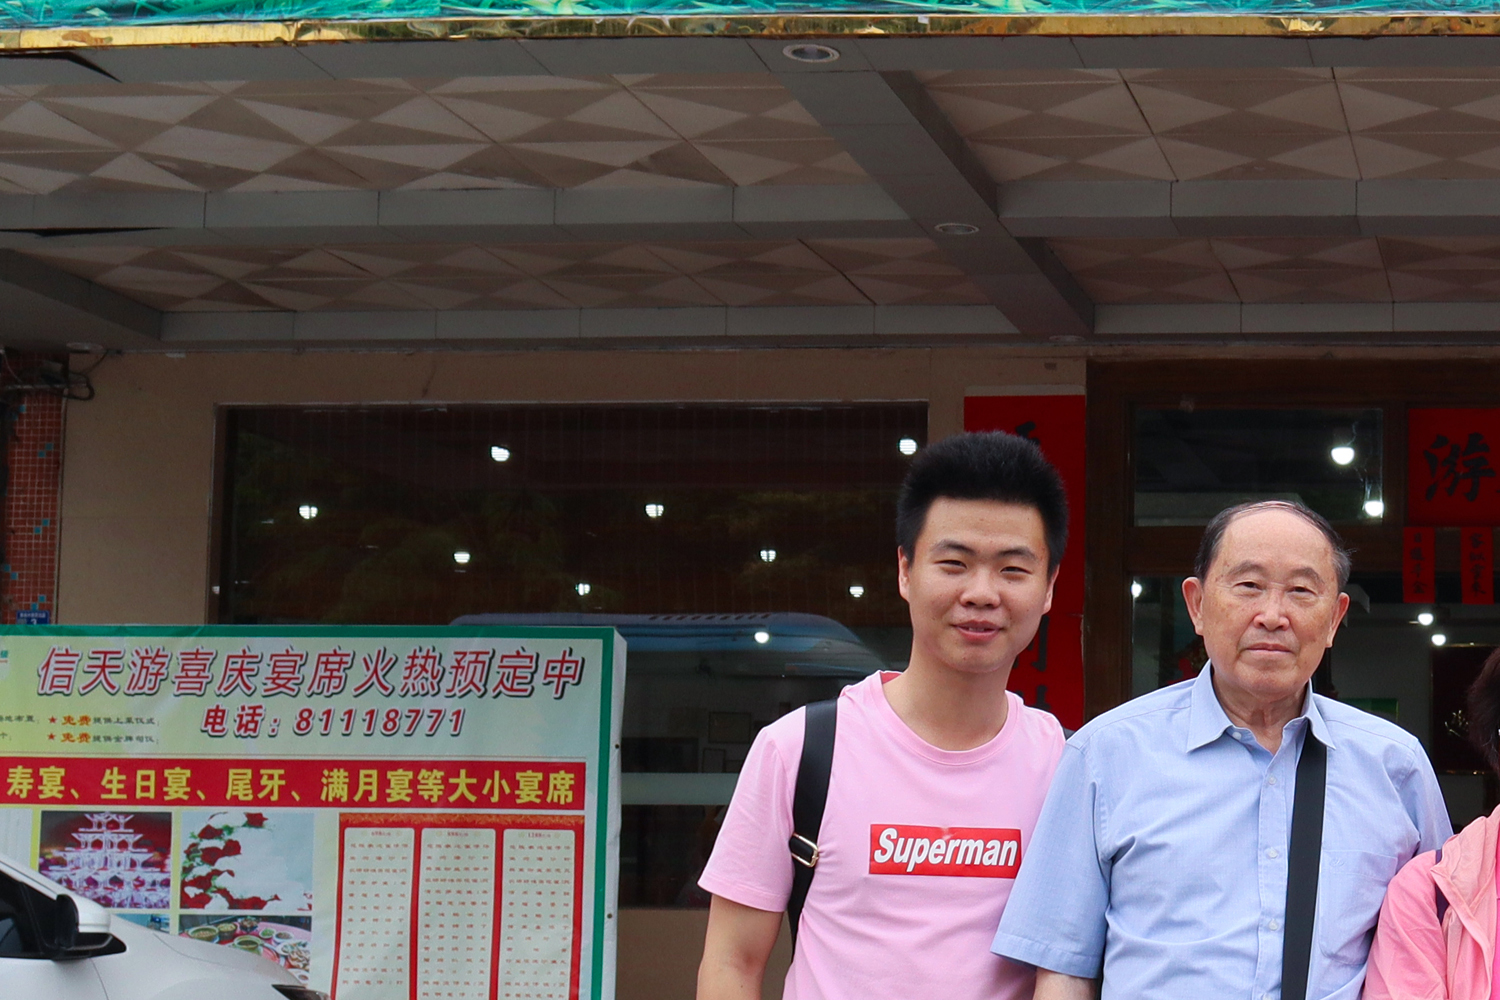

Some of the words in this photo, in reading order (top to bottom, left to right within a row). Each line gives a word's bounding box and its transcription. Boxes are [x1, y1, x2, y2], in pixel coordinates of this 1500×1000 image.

[38, 645, 584, 698] 信天游喜庆宴席火热预定中
[873, 828, 1018, 872] Superman
